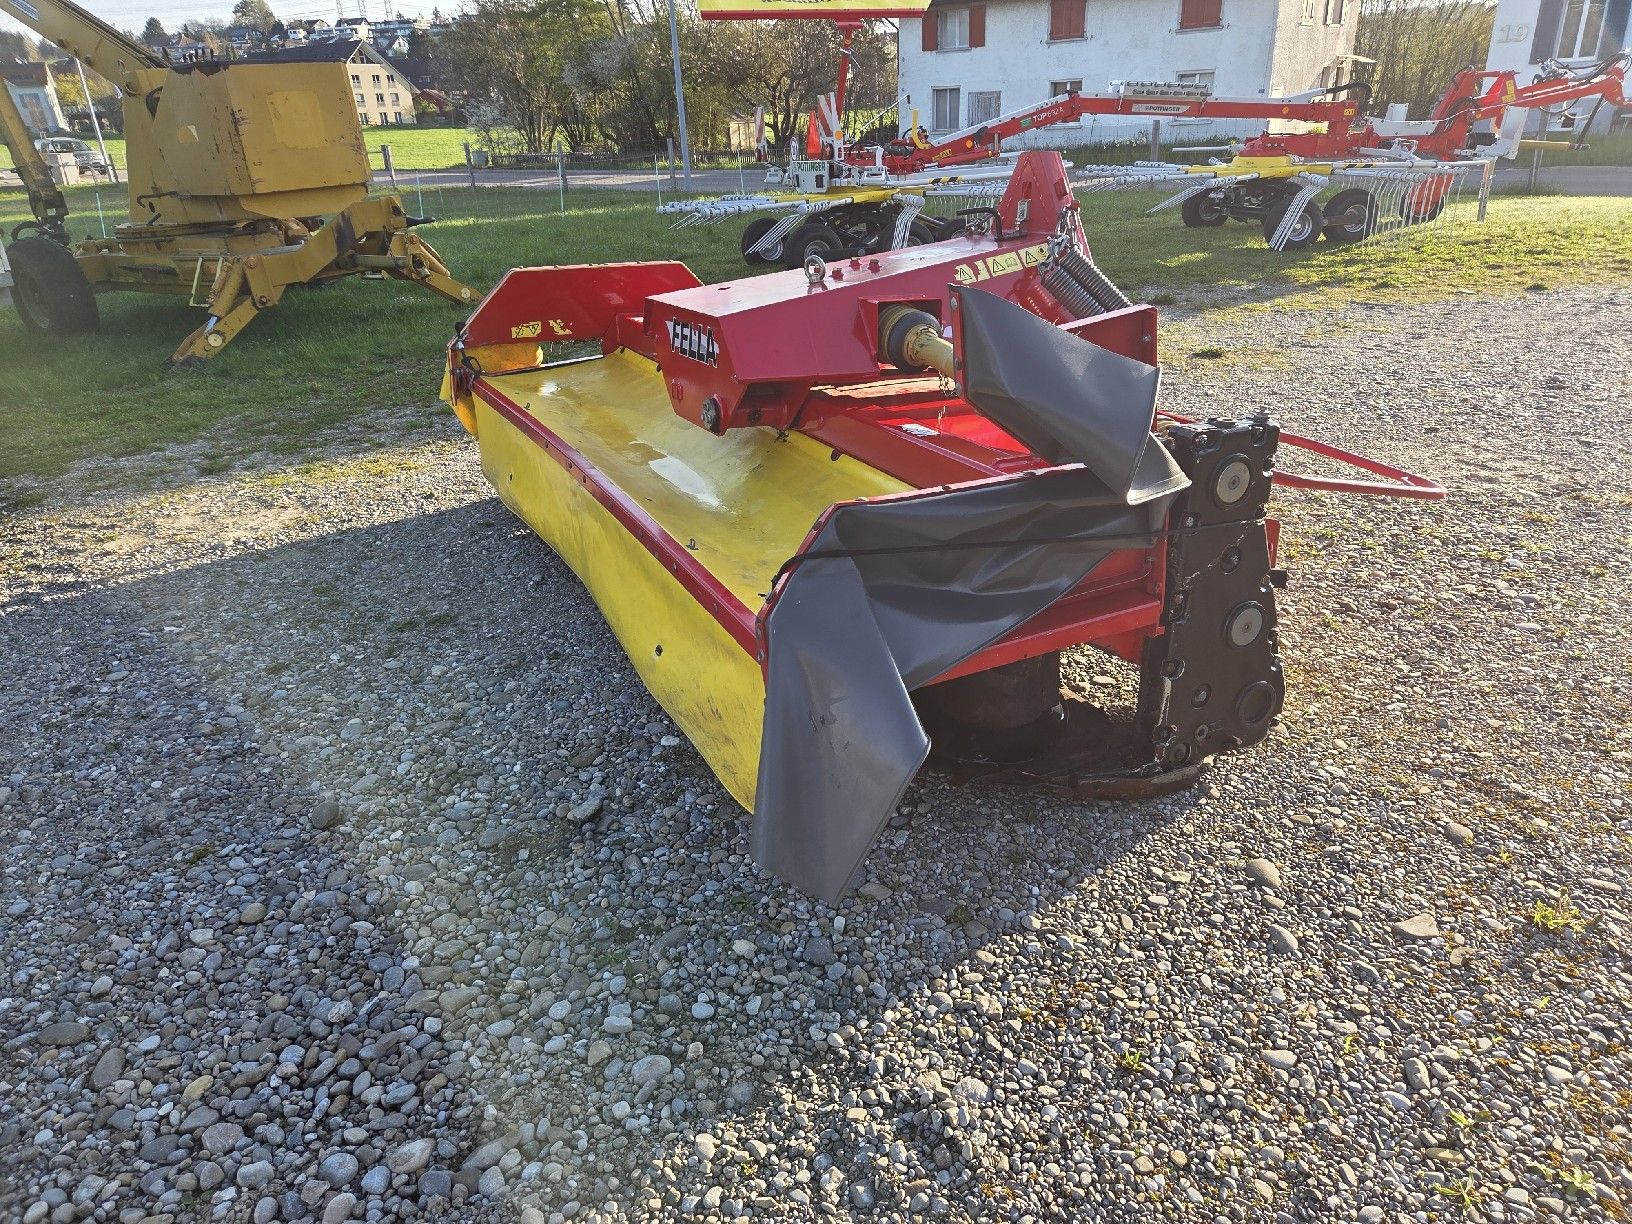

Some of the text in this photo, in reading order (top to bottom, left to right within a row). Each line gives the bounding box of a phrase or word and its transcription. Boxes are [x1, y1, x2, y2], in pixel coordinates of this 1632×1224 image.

[1497, 23, 1528, 43] 19
[1033, 112, 1047, 123] TOP
[671, 316, 718, 369] FELLA
